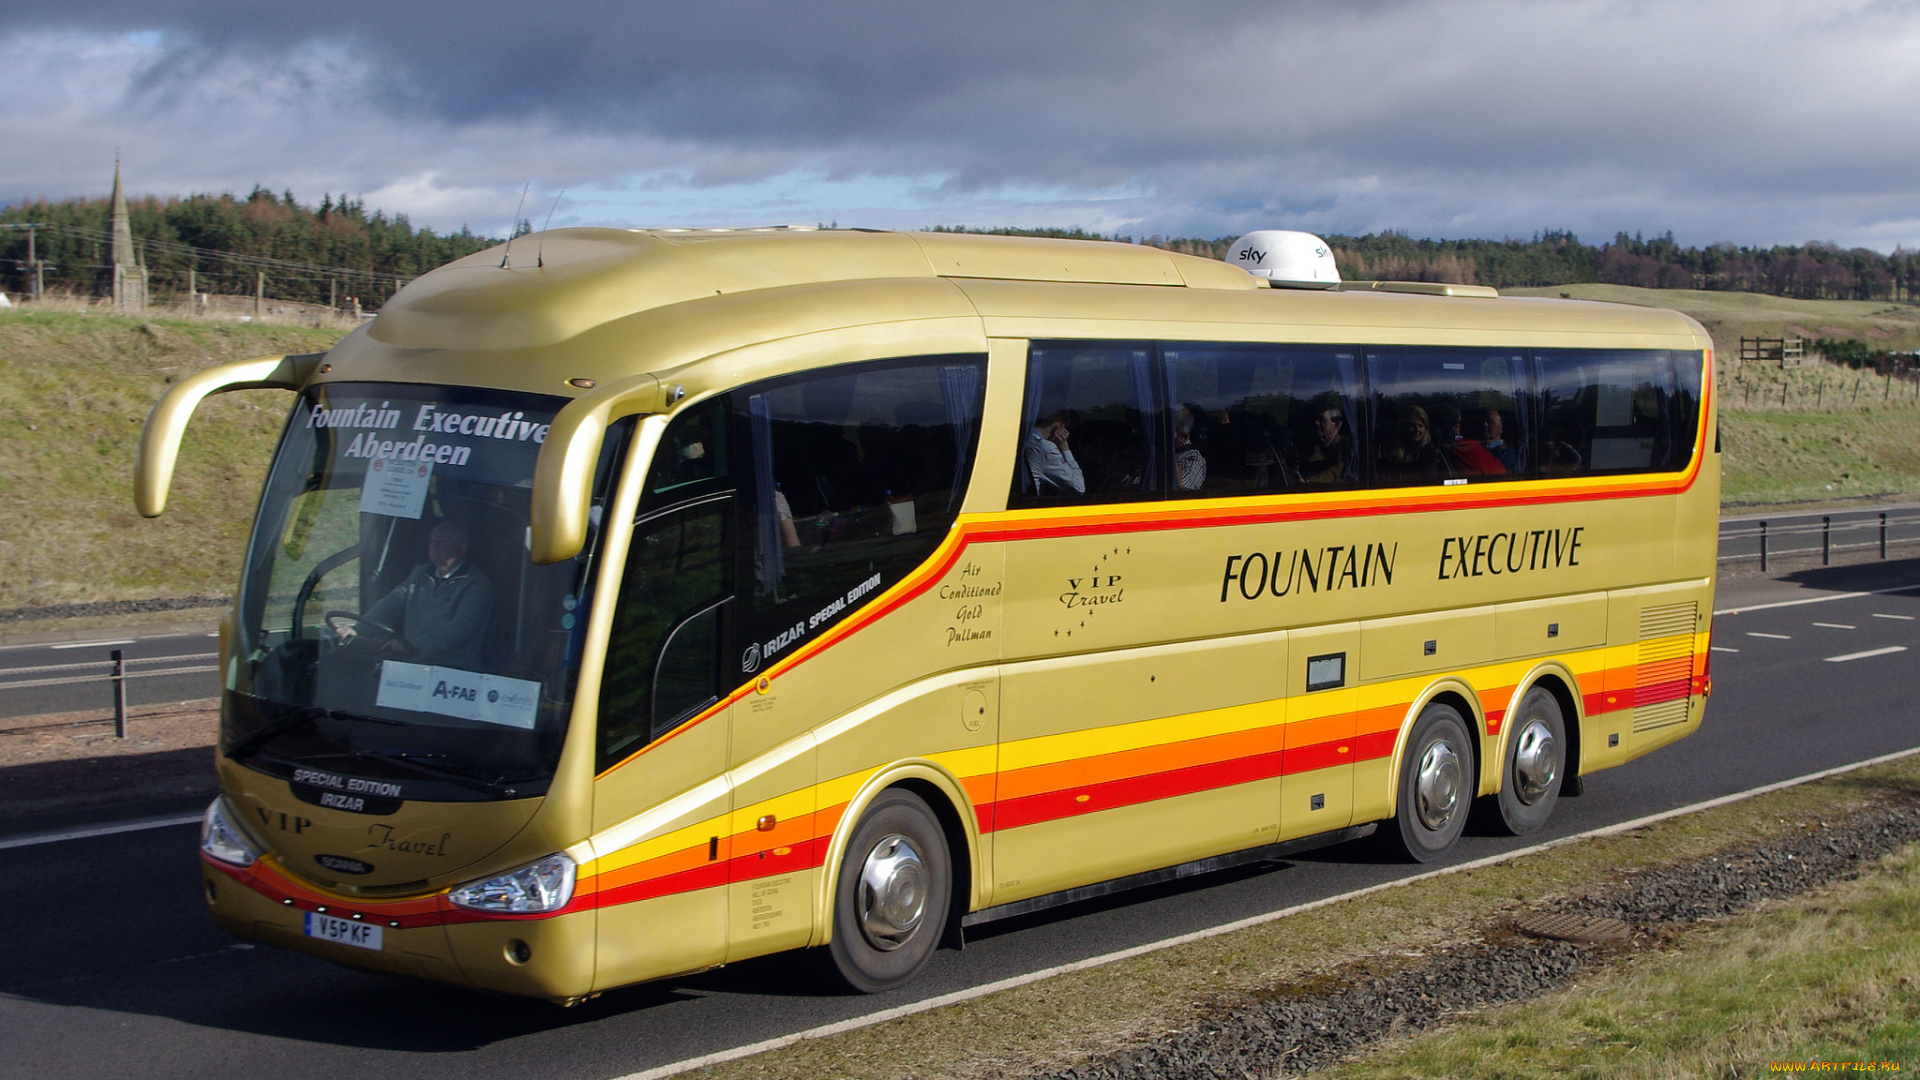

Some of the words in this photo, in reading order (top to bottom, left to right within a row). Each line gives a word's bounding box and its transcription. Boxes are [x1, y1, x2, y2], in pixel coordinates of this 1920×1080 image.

[1239, 246, 1267, 264] sky
[306, 401, 401, 429] Fountain
[413, 404, 552, 444] Executive
[344, 432, 472, 466] Aberdeen
[960, 561, 981, 580] Air
[1220, 541, 1398, 603] FOUNTAIN
[1437, 526, 1585, 580] EXECUTIVE
[939, 581, 1002, 600] Conditioned
[1059, 589, 1124, 609] Travel
[763, 621, 806, 659] IRIZAR
[809, 596, 847, 629] SPECIAL
[847, 572, 881, 604] EDITION
[956, 604, 983, 623] Gold
[945, 627, 992, 647] Pullman
[293, 769, 344, 789] SPECIAL
[347, 778, 402, 797] EDITION
[320, 792, 365, 811] IRIZAR
[367, 823, 450, 857] Travel
[321, 855, 365, 873] SCANIA
